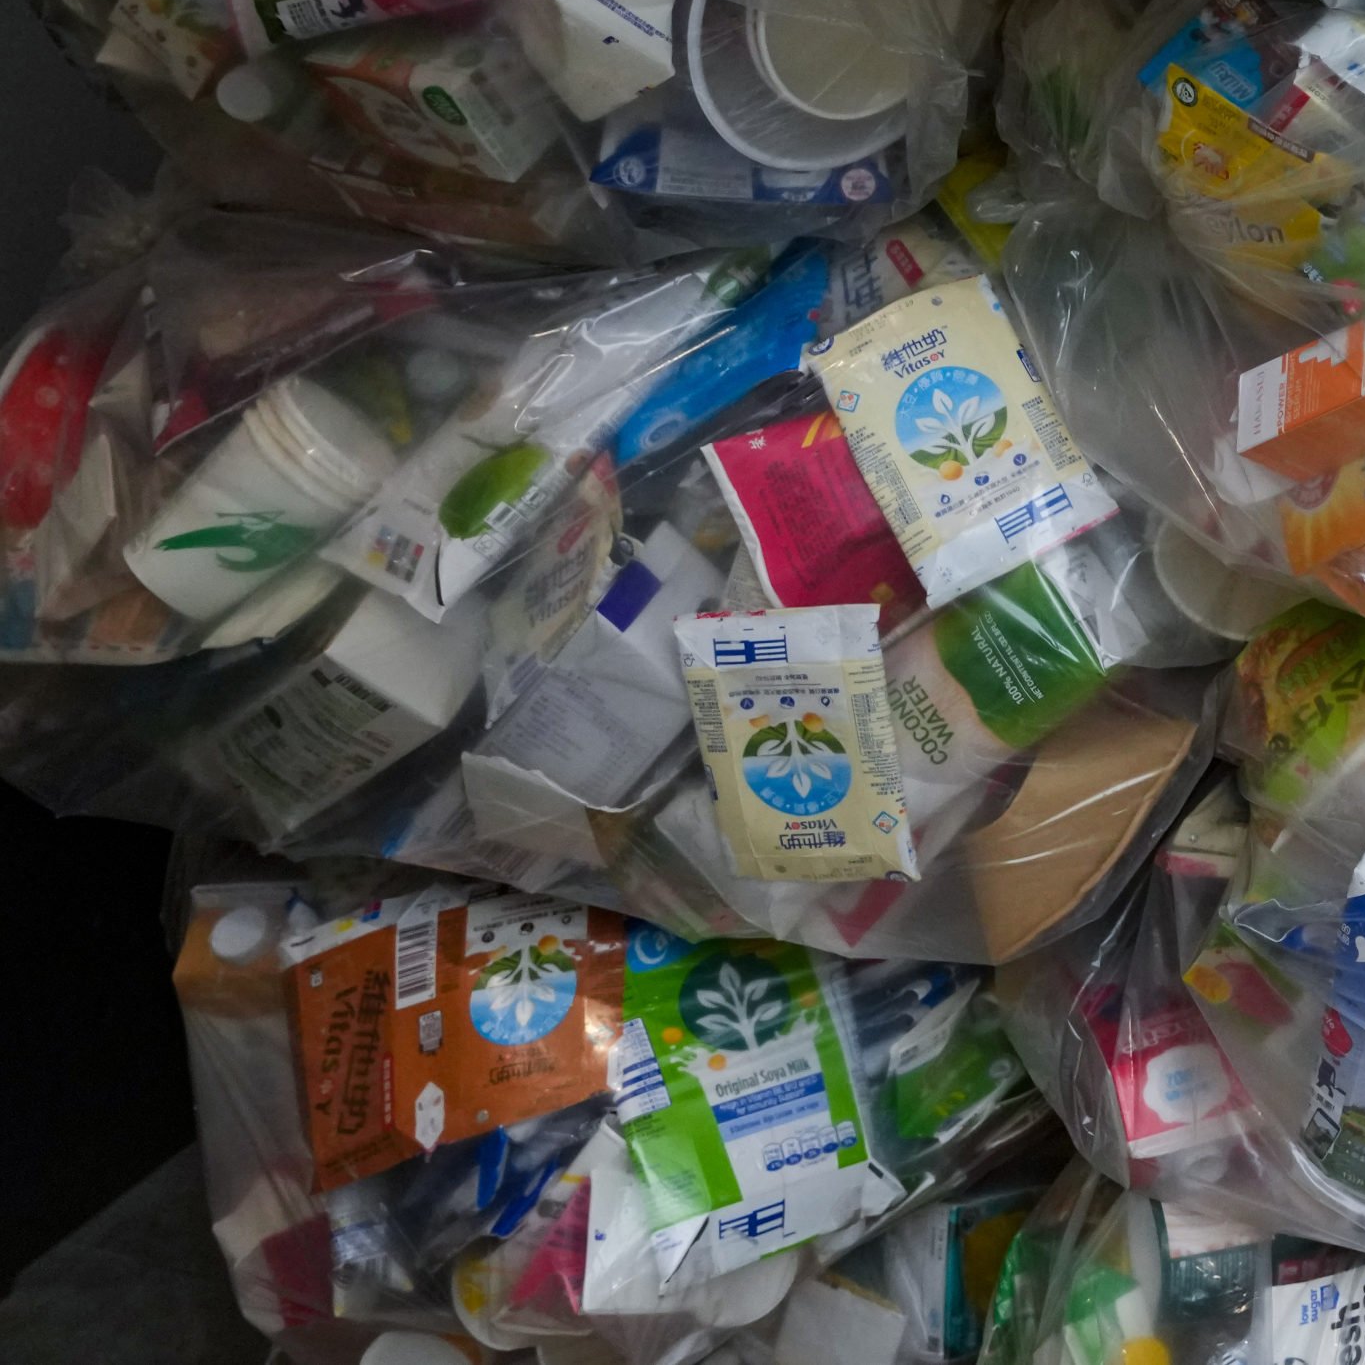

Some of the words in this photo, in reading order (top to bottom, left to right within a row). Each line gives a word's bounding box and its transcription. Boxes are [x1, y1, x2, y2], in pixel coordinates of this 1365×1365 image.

[880, 327, 948, 372] 維他奶
[892, 348, 946, 379] Vitasoy
[969, 623, 1009, 677] NATURAL
[999, 675, 1025, 706] 100%
[905, 675, 955, 746] WATER
[779, 829, 846, 850] 維他奶
[784, 818, 839, 832] Vitasoy
[315, 985, 358, 1115] Vitasoy
[337, 968, 391, 1135] 維他奶
[714, 1070, 759, 1097] Original
[758, 1064, 788, 1088] Soya
[786, 1058, 811, 1080] Milk
[1300, 1303, 1309, 1326] low
[1310, 1289, 1321, 1323] sugar
